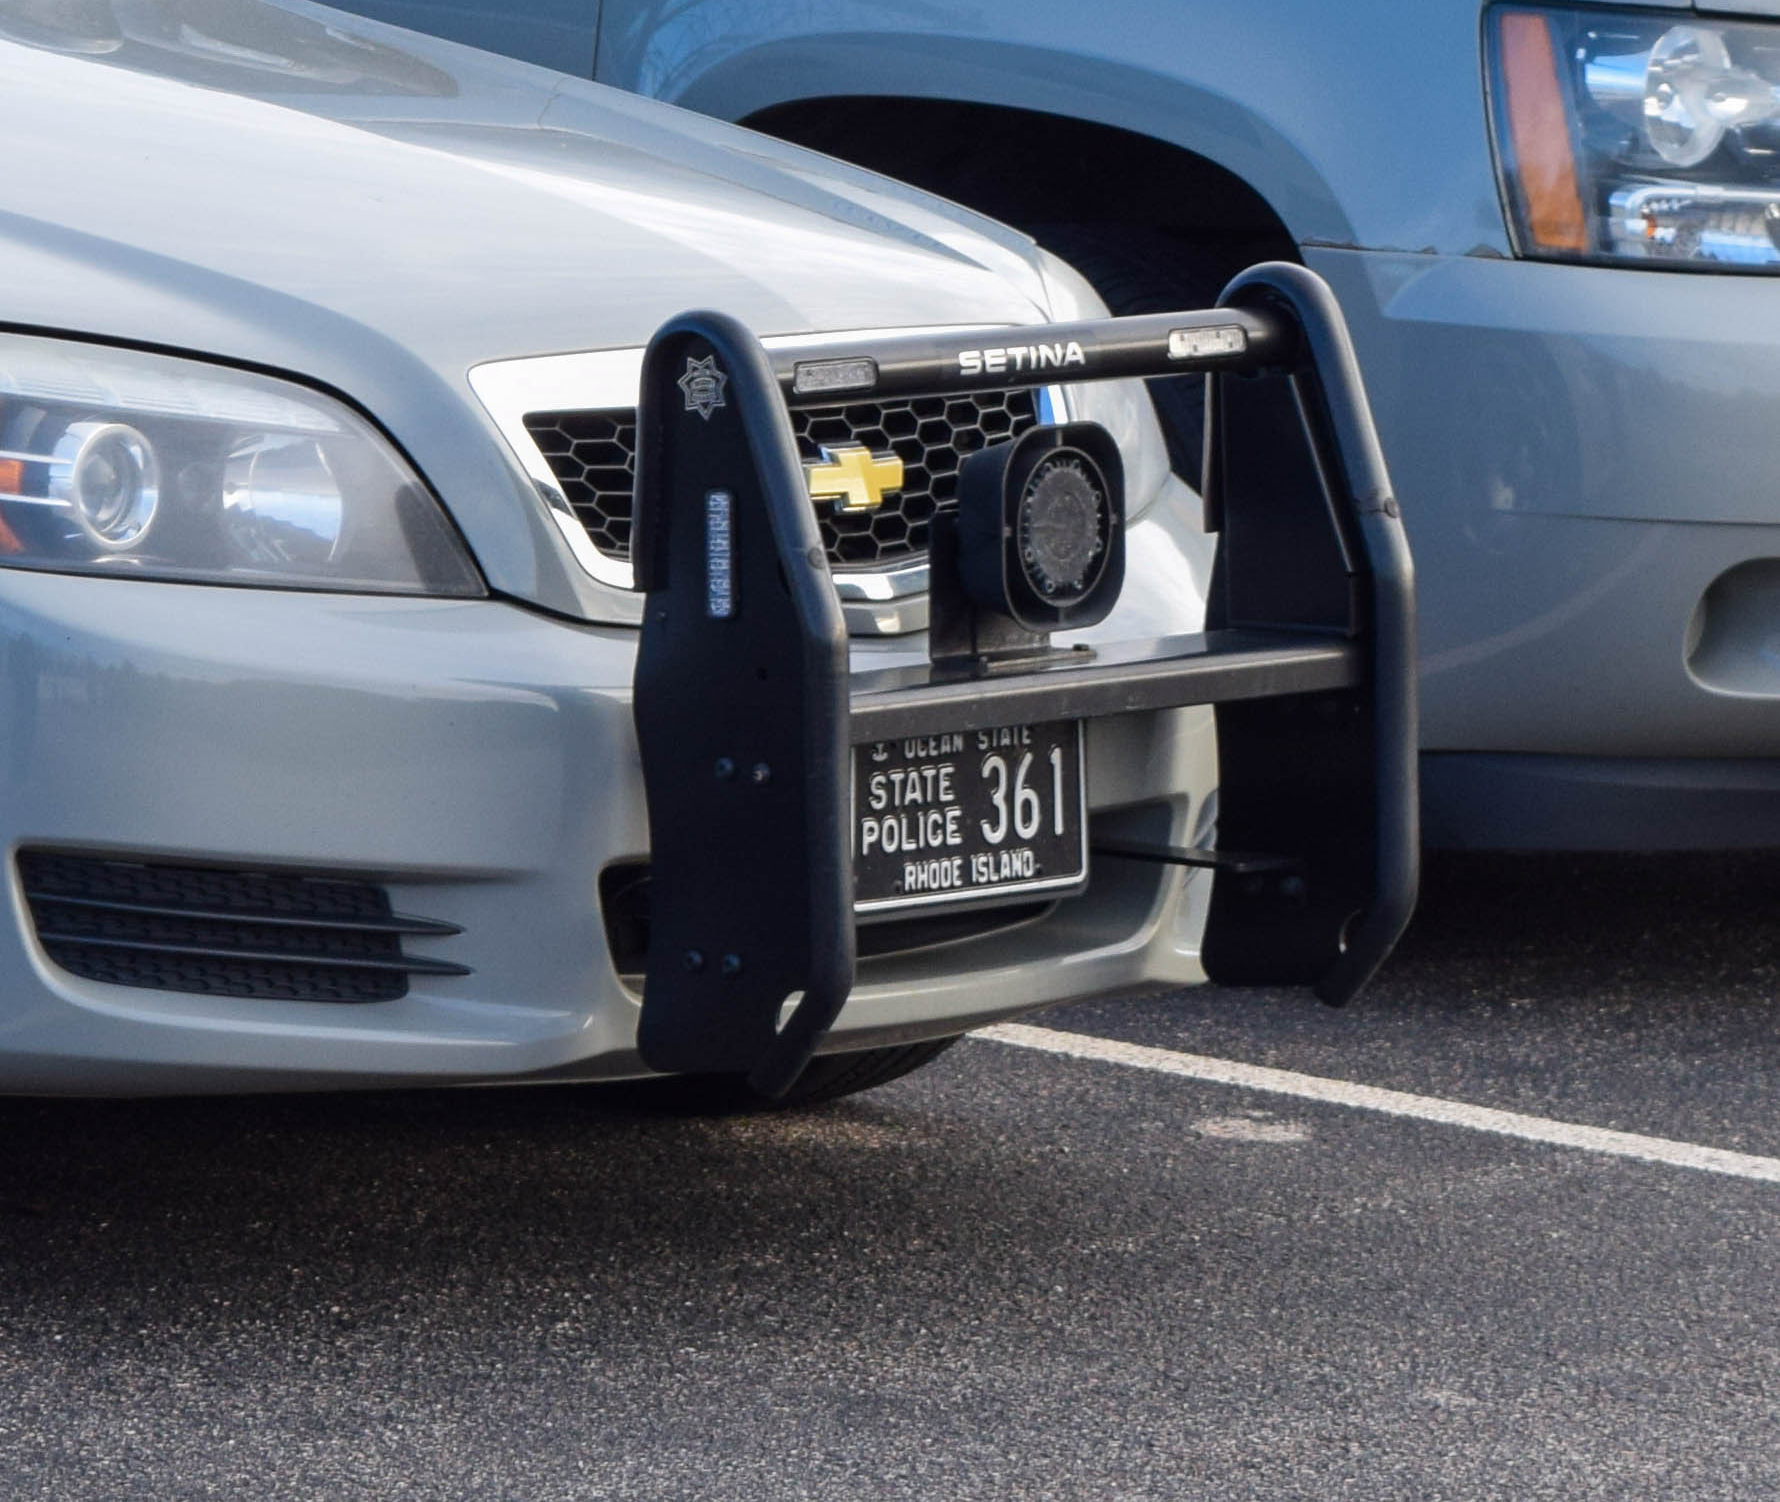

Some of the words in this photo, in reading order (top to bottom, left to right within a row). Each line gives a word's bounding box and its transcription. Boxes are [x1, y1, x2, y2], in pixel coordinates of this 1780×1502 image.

[958, 341, 1086, 376] SETINA
[869, 763, 956, 810] STATE
[980, 744, 1064, 844] 361
[861, 806, 963, 855] POLICE
[904, 856, 963, 891] RHODE
[971, 848, 1035, 884] ISLAND
